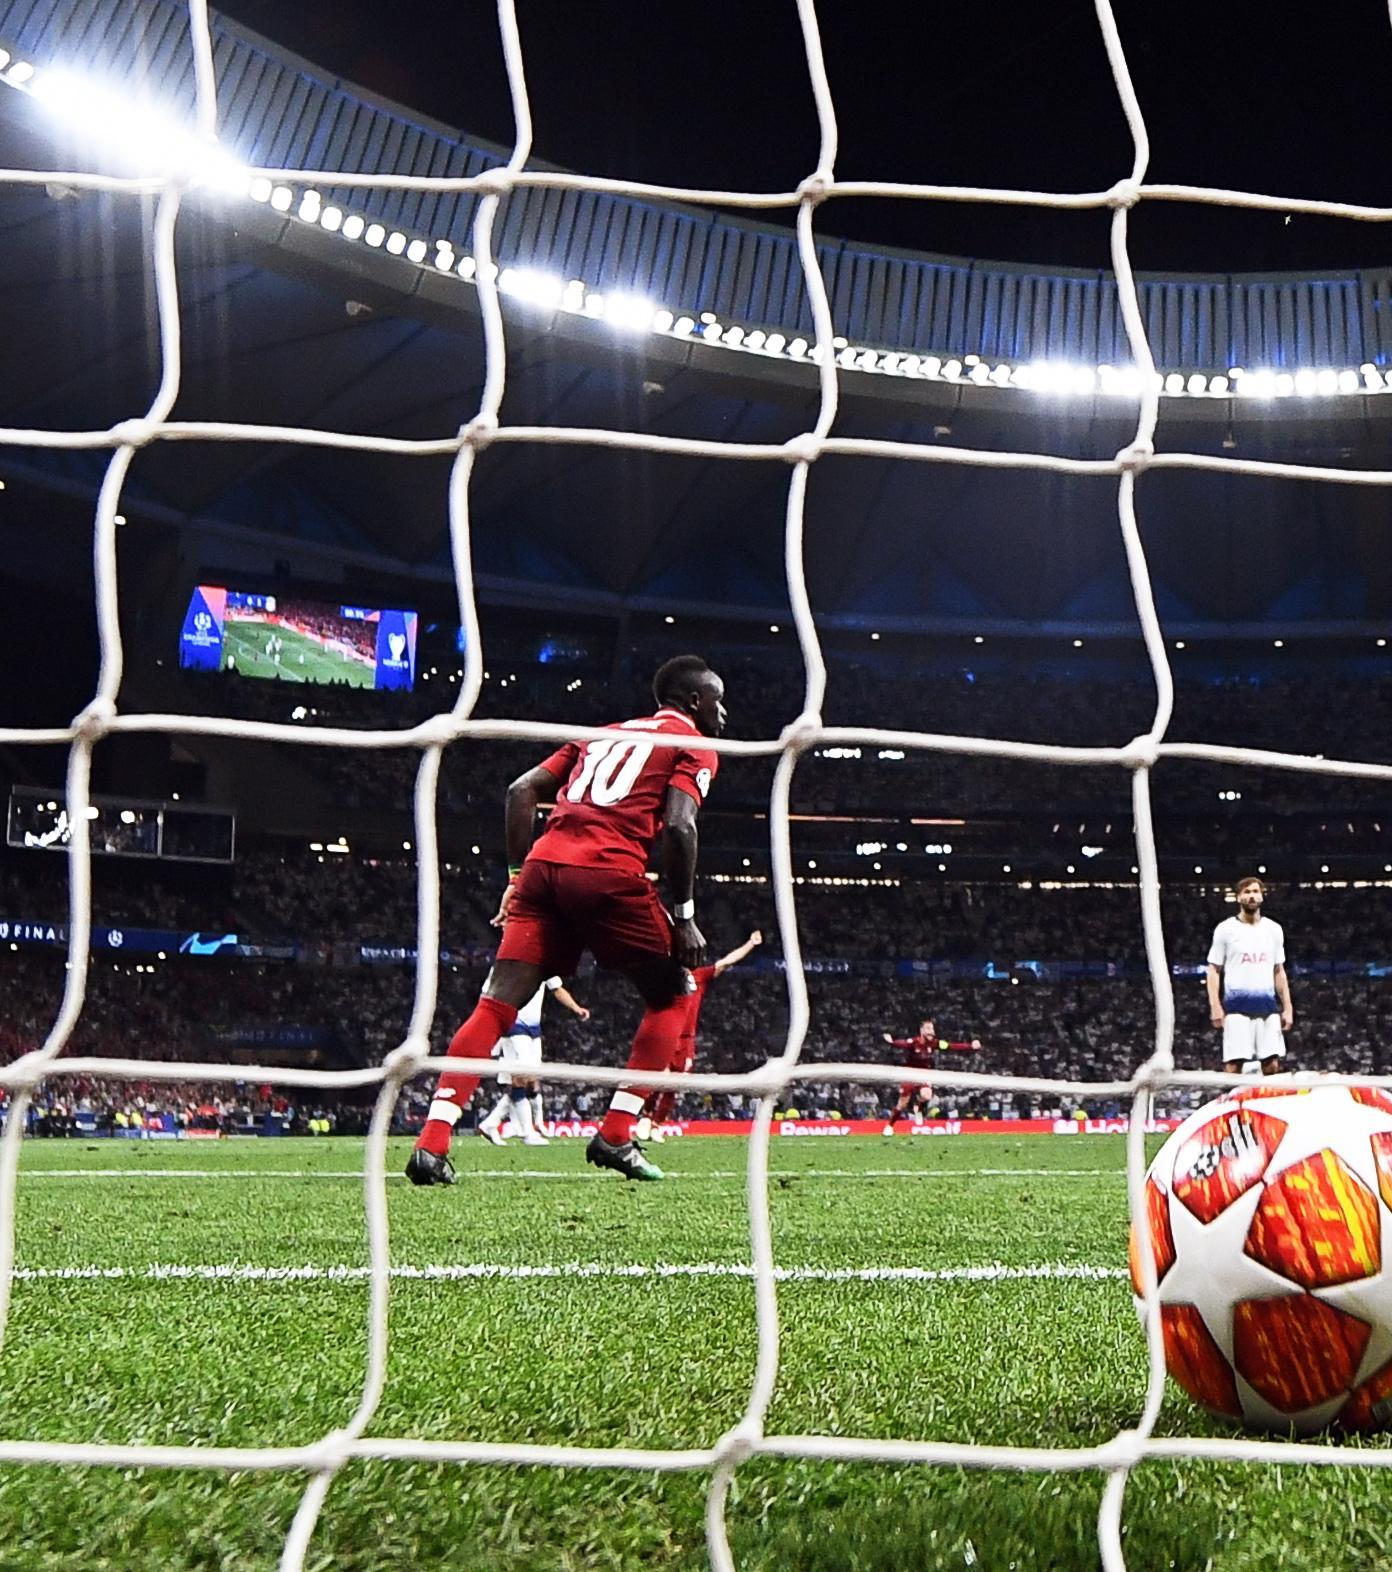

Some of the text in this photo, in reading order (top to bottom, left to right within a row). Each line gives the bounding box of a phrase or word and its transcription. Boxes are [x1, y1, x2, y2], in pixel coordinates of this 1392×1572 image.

[567, 737, 655, 806] 10
[14, 923, 67, 941] FINAL
[1240, 952, 1268, 965] AIA
